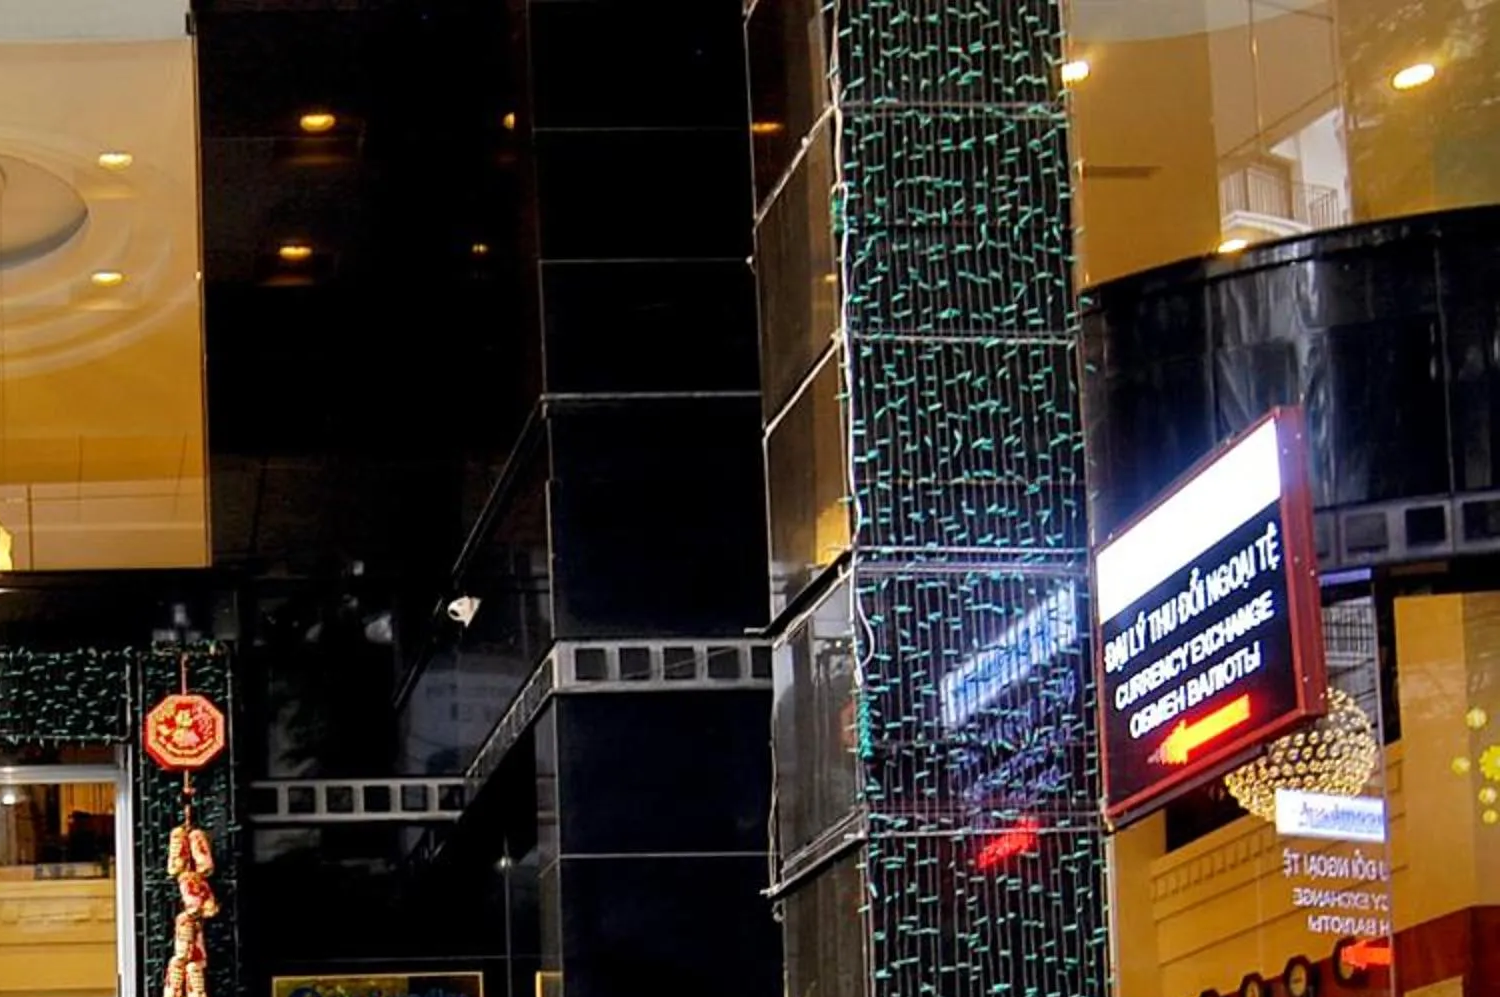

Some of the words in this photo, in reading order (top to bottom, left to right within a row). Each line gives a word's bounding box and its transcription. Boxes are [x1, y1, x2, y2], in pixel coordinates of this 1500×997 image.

[1115, 643, 1189, 709] CURRENCY
[1191, 589, 1274, 664] EXCHANGE
[1128, 611, 1147, 656] LÝ
[1147, 598, 1177, 642] THU
